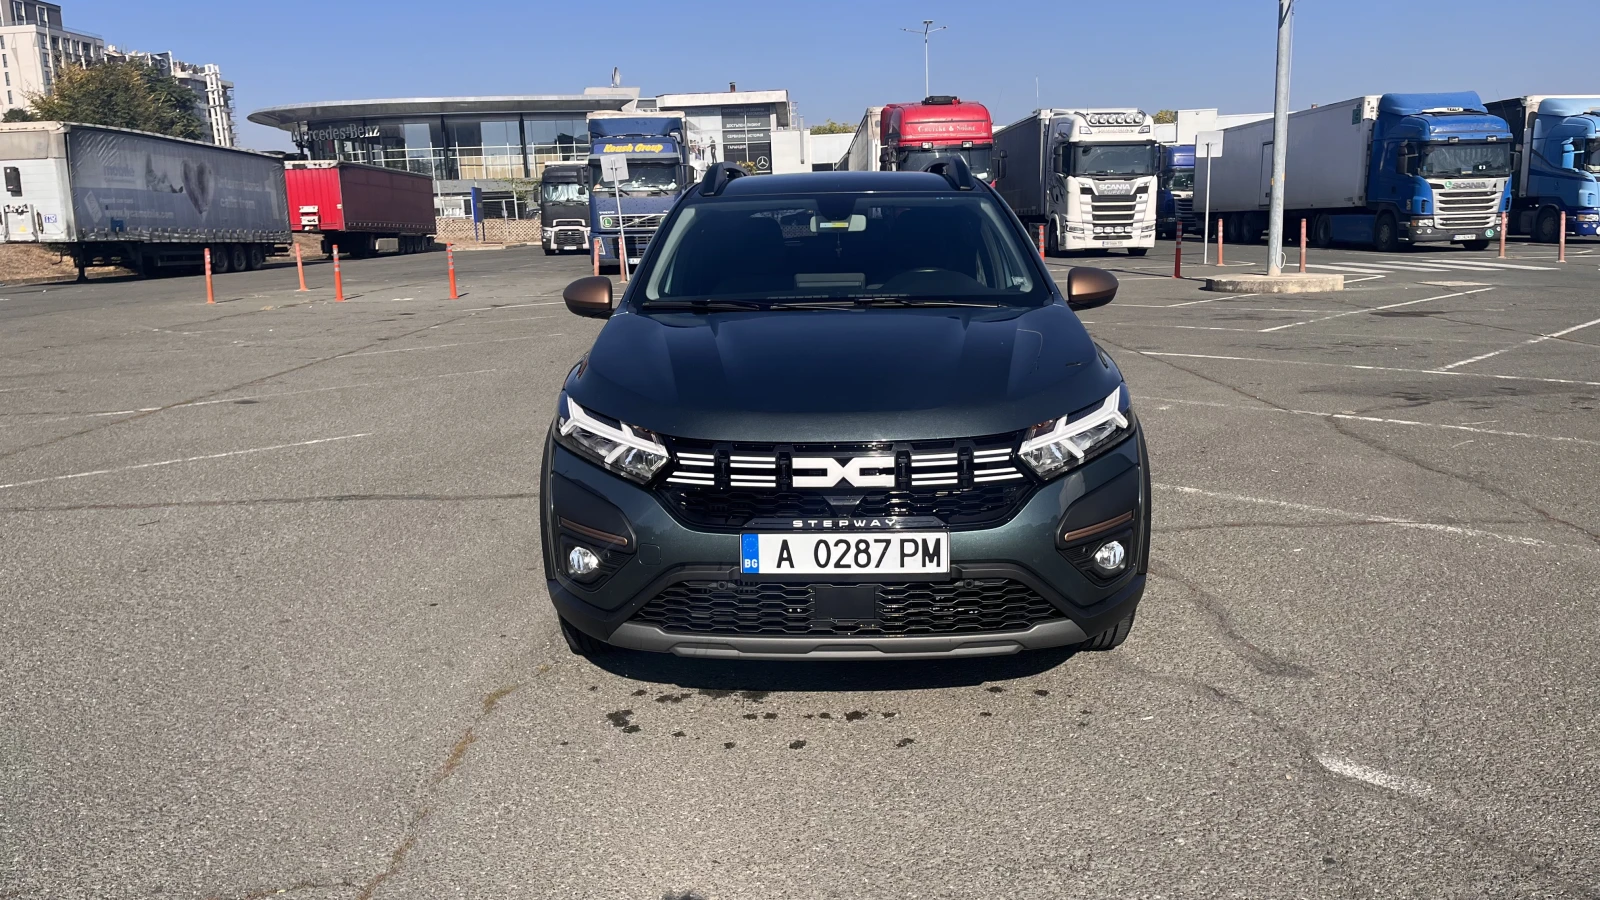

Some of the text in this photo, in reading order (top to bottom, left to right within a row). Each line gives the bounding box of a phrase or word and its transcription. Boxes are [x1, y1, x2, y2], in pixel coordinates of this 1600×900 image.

[292, 123, 380, 143] Mercedes-Benz
[634, 143, 664, 153] Group
[1098, 183, 1131, 191] SCANIA
[1452, 181, 1488, 190] SCANIA
[792, 518, 896, 528] STEPWAY
[776, 537, 941, 569] A 0287 PM
[744, 558, 758, 569] BG
